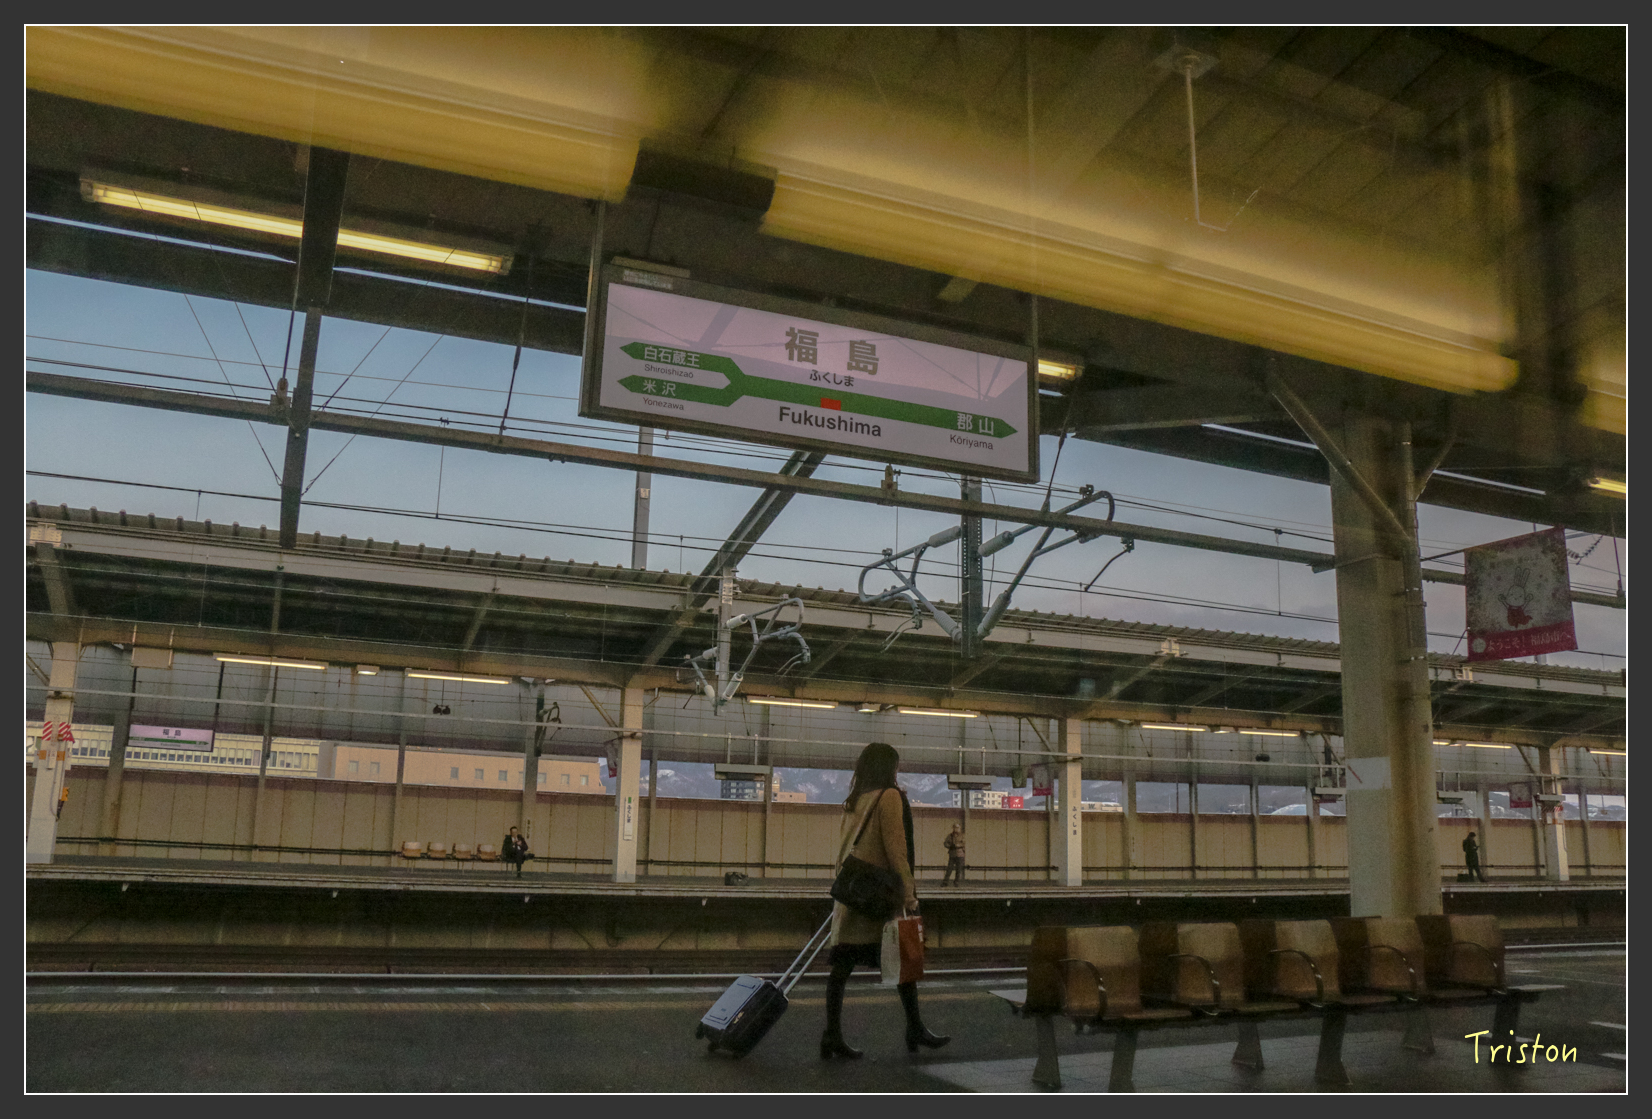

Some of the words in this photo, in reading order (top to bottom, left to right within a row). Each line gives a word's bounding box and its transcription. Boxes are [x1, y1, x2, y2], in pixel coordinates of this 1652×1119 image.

[644, 346, 700, 368] 白石蔵王
[784, 326, 880, 376] 福島
[644, 363, 694, 379] Shiroishizaō
[809, 369, 855, 387] ふくしま
[642, 379, 677, 397] 米沢
[642, 396, 685, 411] Yonezawa
[779, 405, 882, 437] Fukushima
[956, 412, 994, 436] 郡山
[949, 433, 994, 450] Kōriyama
